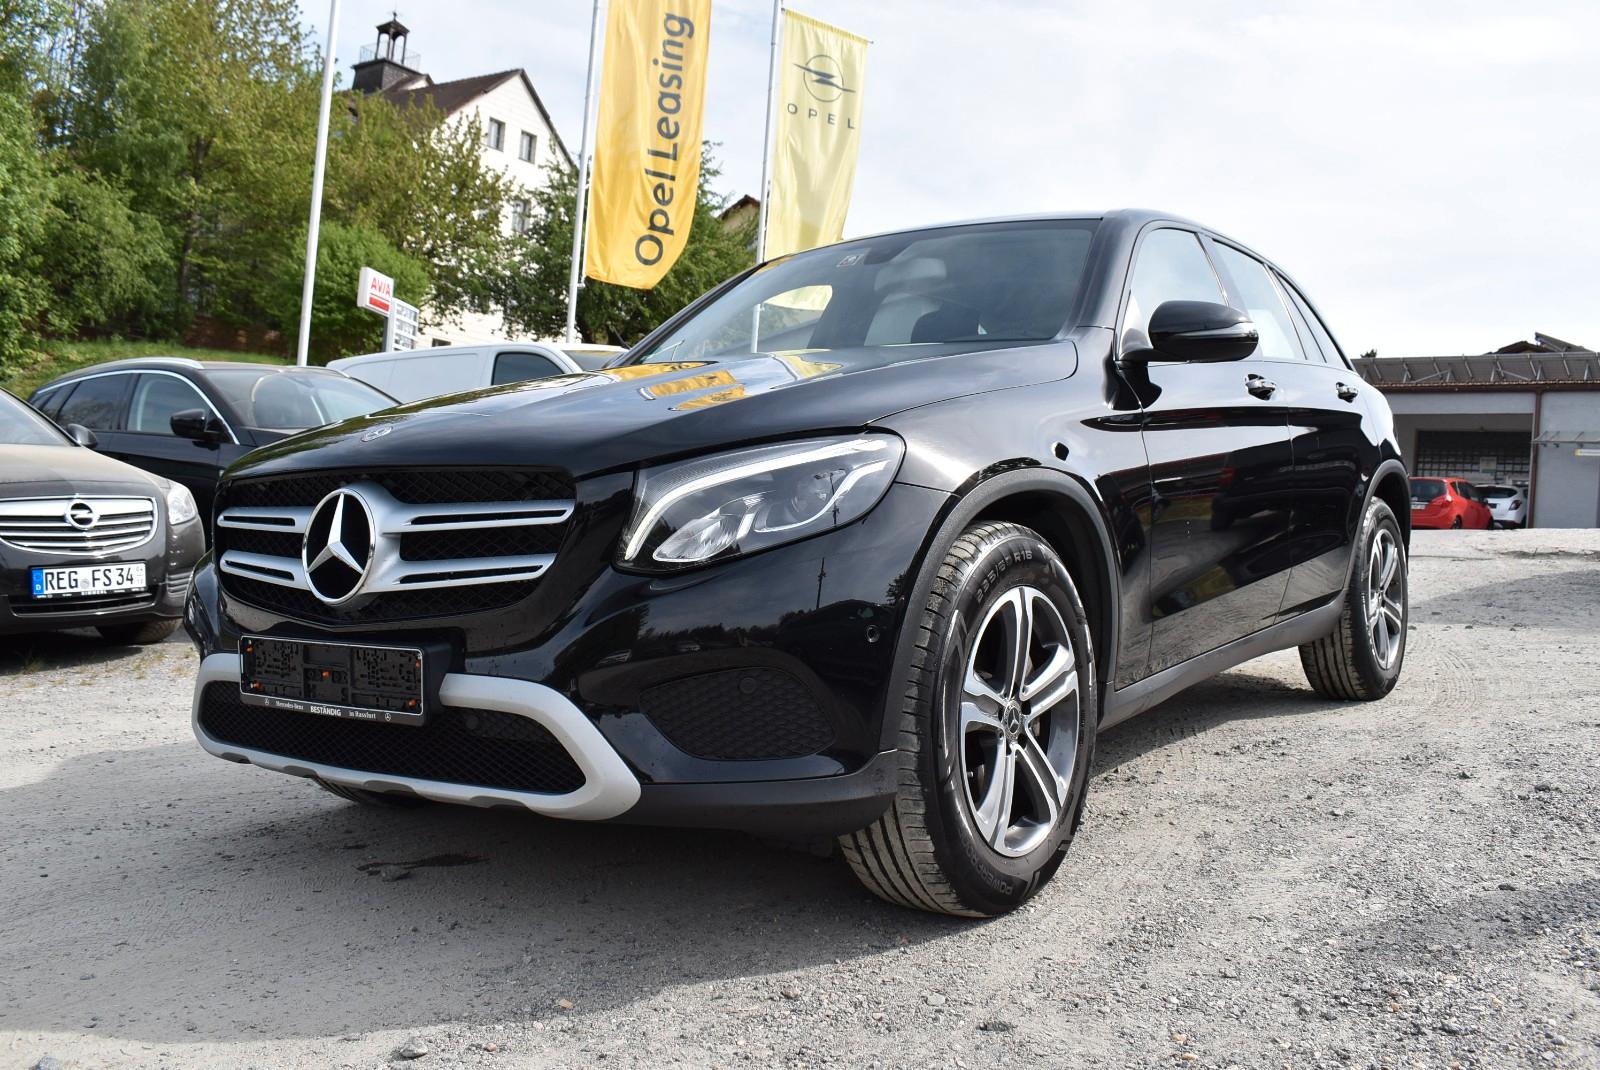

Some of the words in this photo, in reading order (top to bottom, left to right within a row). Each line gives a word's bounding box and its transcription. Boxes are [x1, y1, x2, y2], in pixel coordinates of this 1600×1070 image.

[647, 12, 695, 161] Leasing
[787, 103, 855, 130] OPEL
[635, 167, 676, 266] Opel
[371, 277, 391, 297] AVIA
[45, 570, 78, 591] REG
[92, 568, 112, 588] FS
[116, 567, 134, 586] 34
[310, 705, 342, 717] BESTÄNDIG
